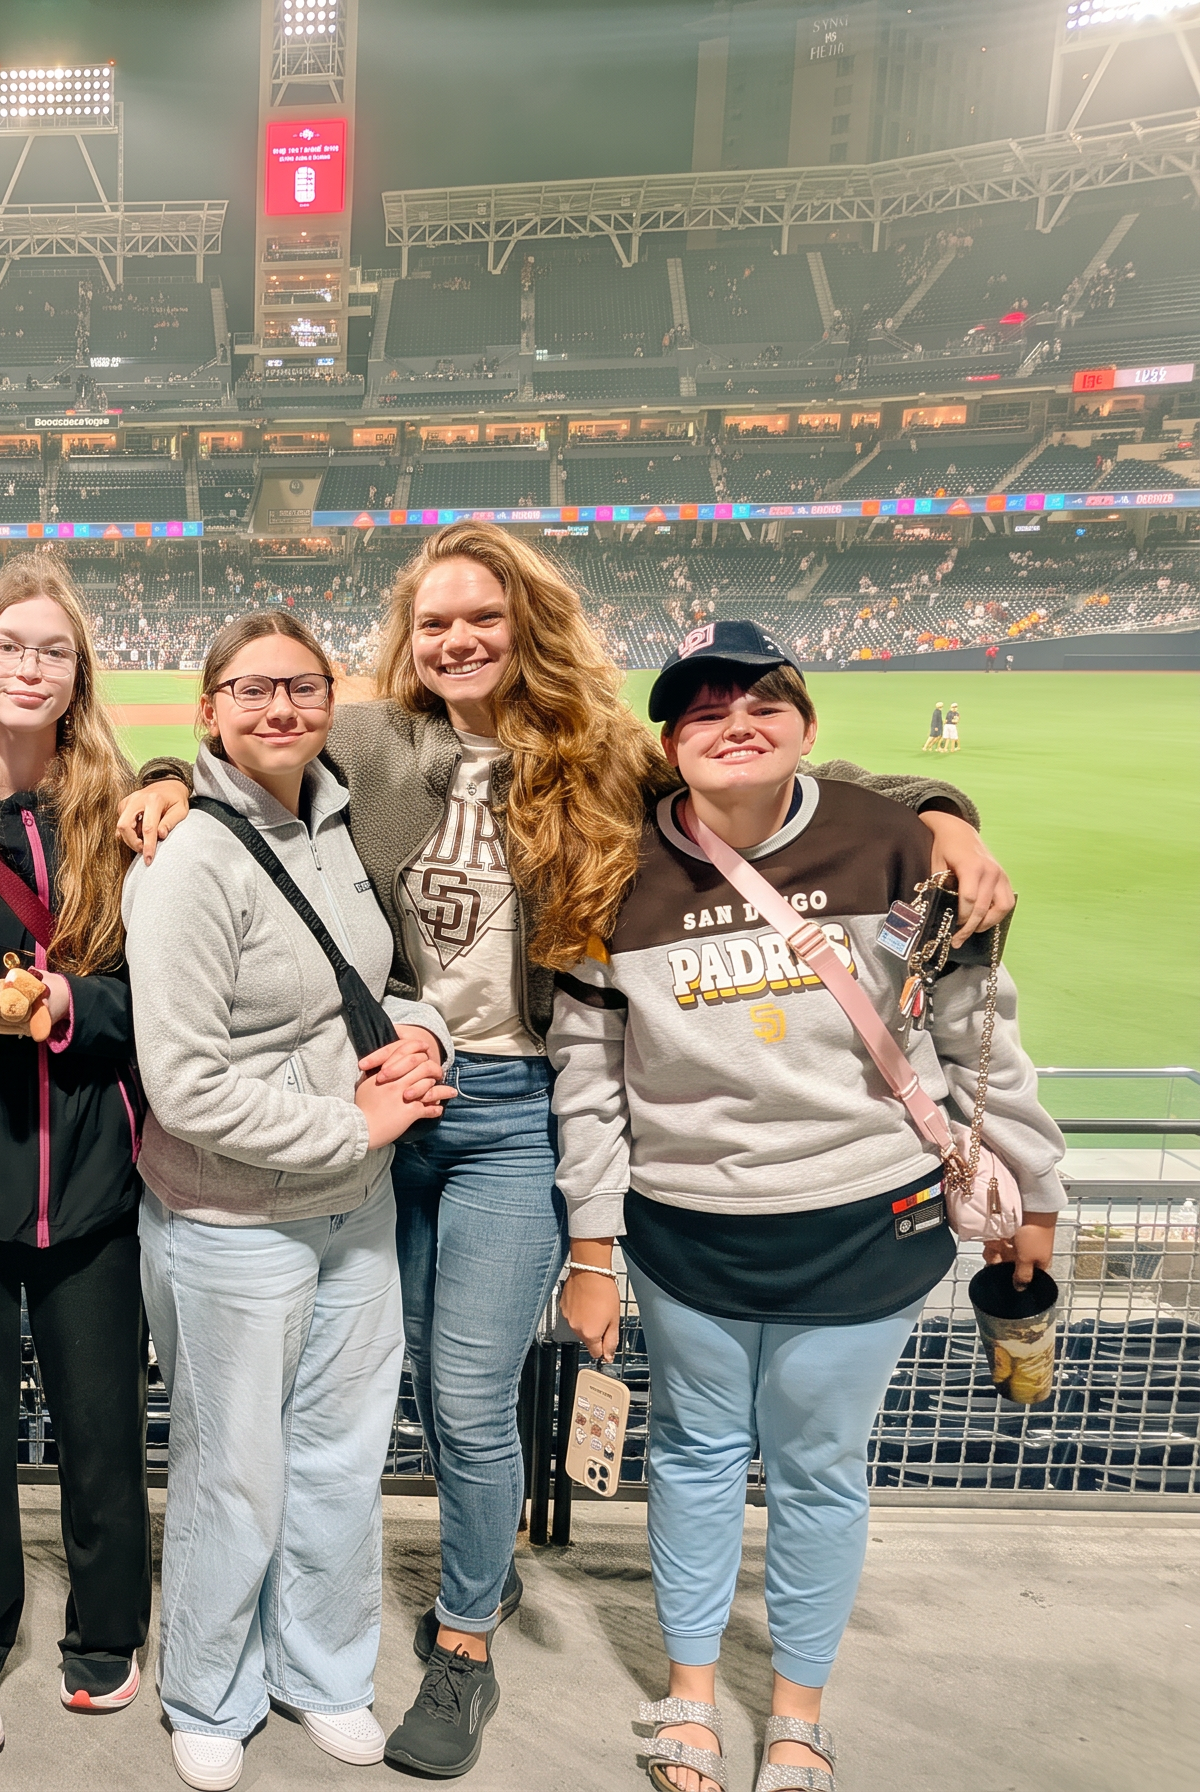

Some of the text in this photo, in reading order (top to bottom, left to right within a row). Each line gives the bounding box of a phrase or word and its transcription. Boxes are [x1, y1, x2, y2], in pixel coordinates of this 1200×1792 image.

[418, 867, 482, 947] SD
[683, 890, 828, 931] SAN DGO
[668, 921, 860, 1010] PADRS
